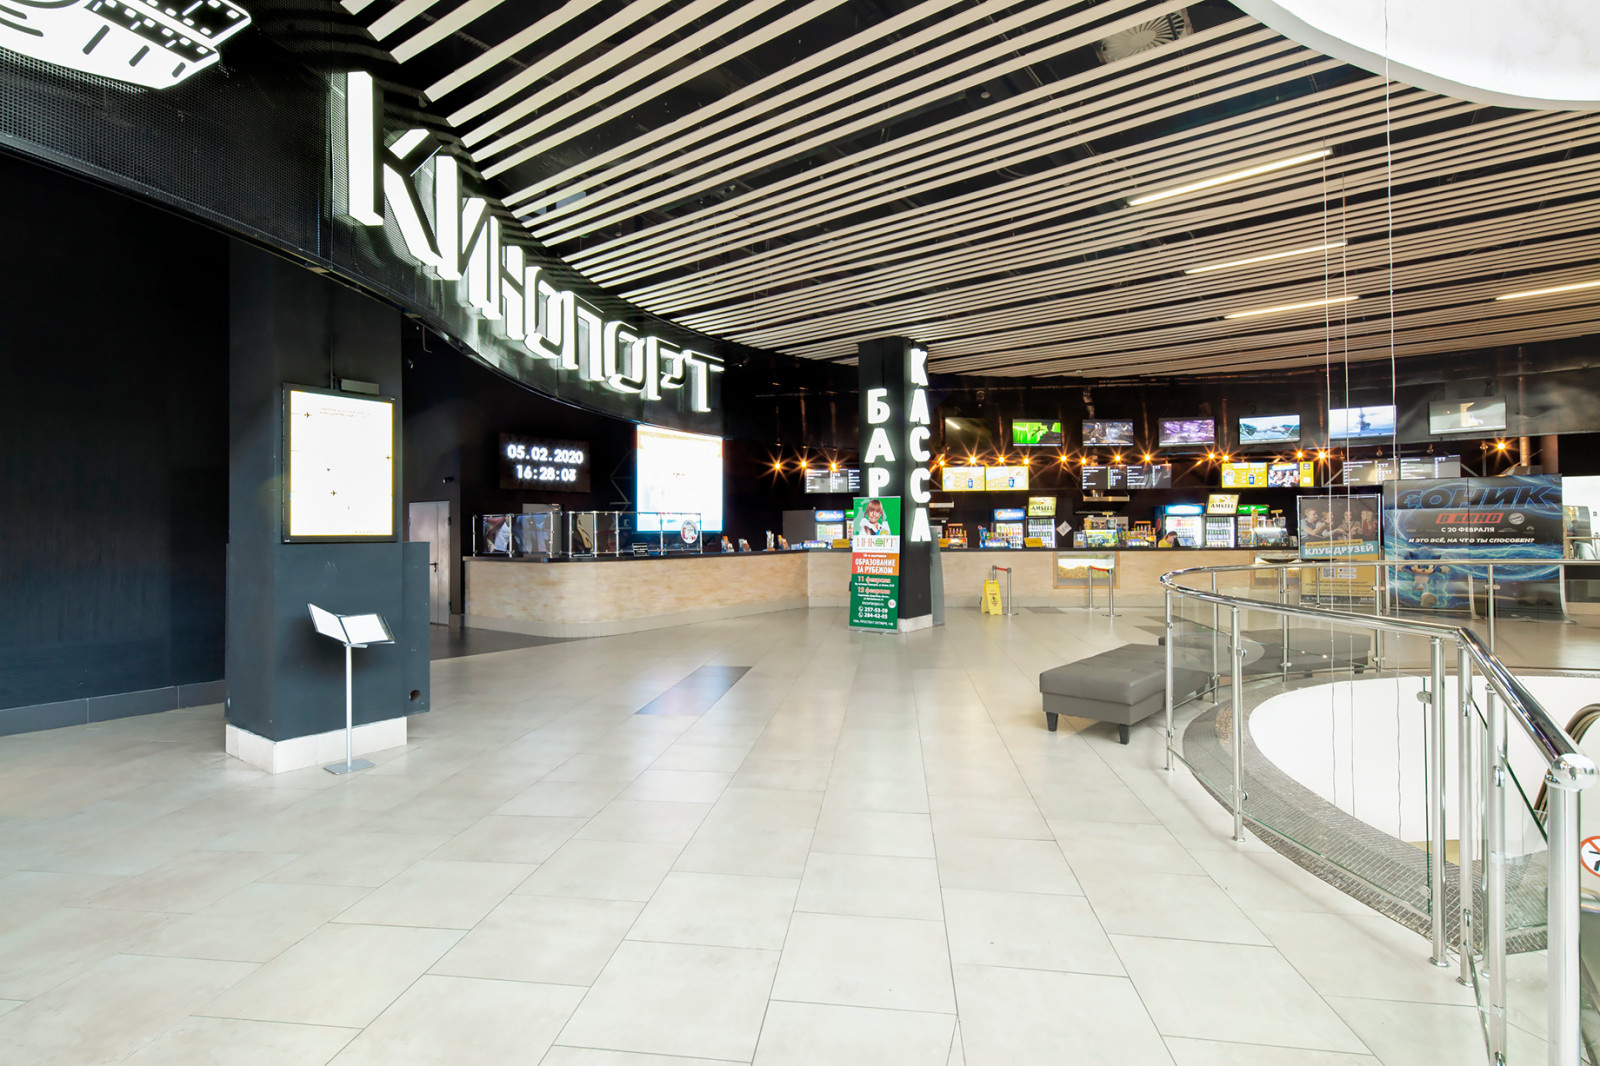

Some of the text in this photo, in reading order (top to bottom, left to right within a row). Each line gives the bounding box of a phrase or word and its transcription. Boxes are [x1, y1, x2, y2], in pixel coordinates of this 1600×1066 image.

[864, 388, 896, 497] БАР
[909, 348, 932, 542] КАССА
[506, 443, 584, 464] 05.02.2020
[1397, 486, 1558, 510] СОНИК
[1451, 513, 1502, 523] КИНО
[1305, 547, 1332, 556] КЛУБ
[1333, 543, 1374, 555] ДРУЗЕЙ
[855, 558, 896, 567] ОБРАЗОВАНИЕ
[864, 566, 893, 574] РУБЕЖОМ
